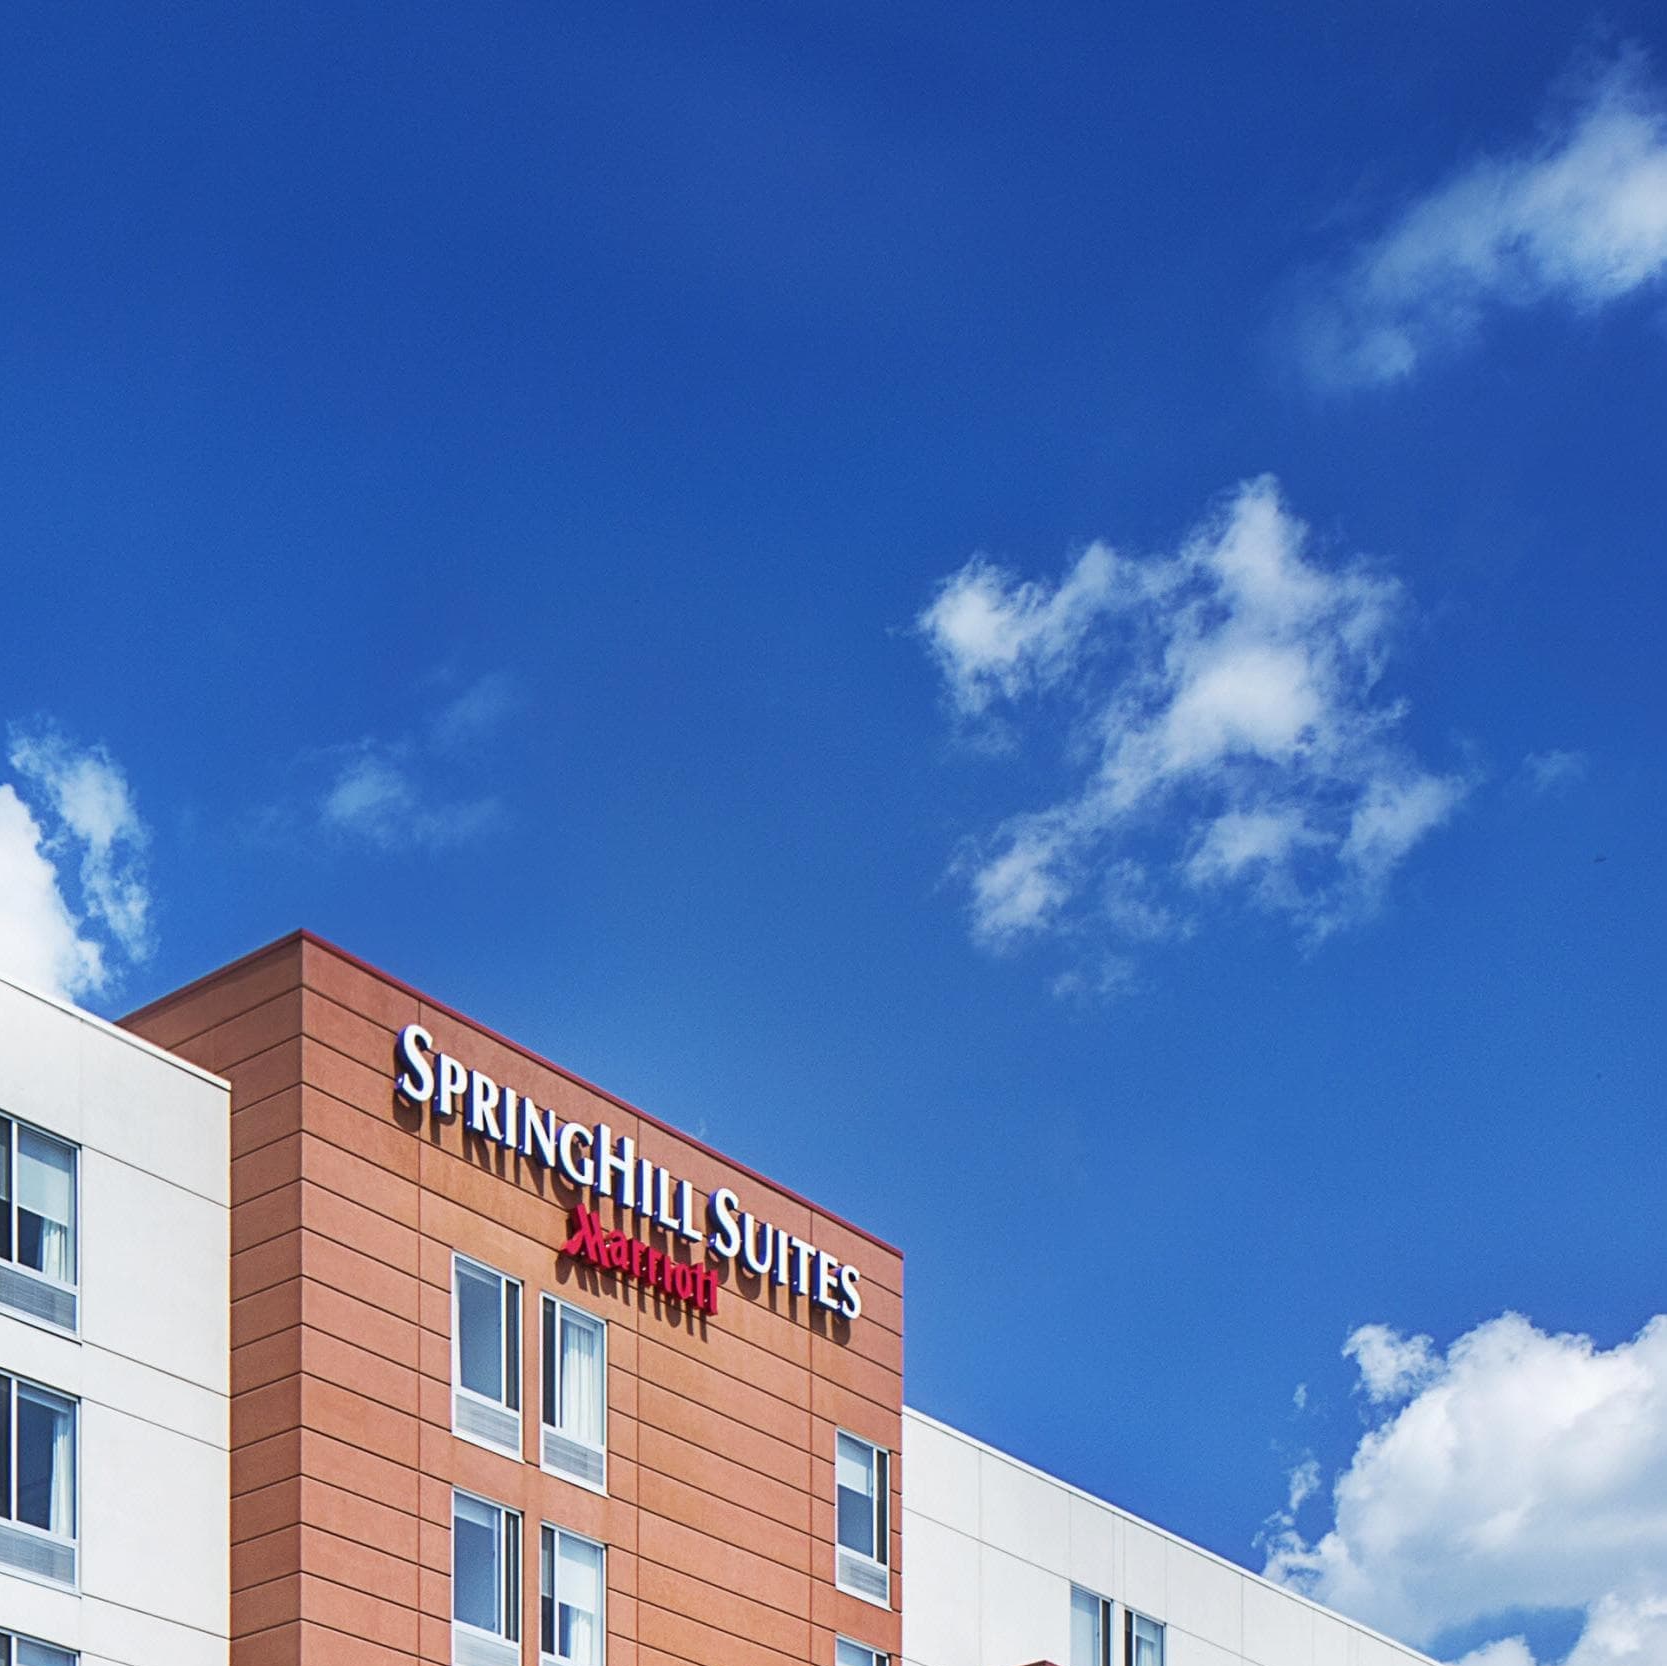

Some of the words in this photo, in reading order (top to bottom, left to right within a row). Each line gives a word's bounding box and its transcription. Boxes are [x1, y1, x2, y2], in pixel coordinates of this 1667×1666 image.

[397, 1023, 703, 1243] SPRINGHILL
[708, 1187, 862, 1321] SUITES
[561, 1202, 720, 1316] Marriott
